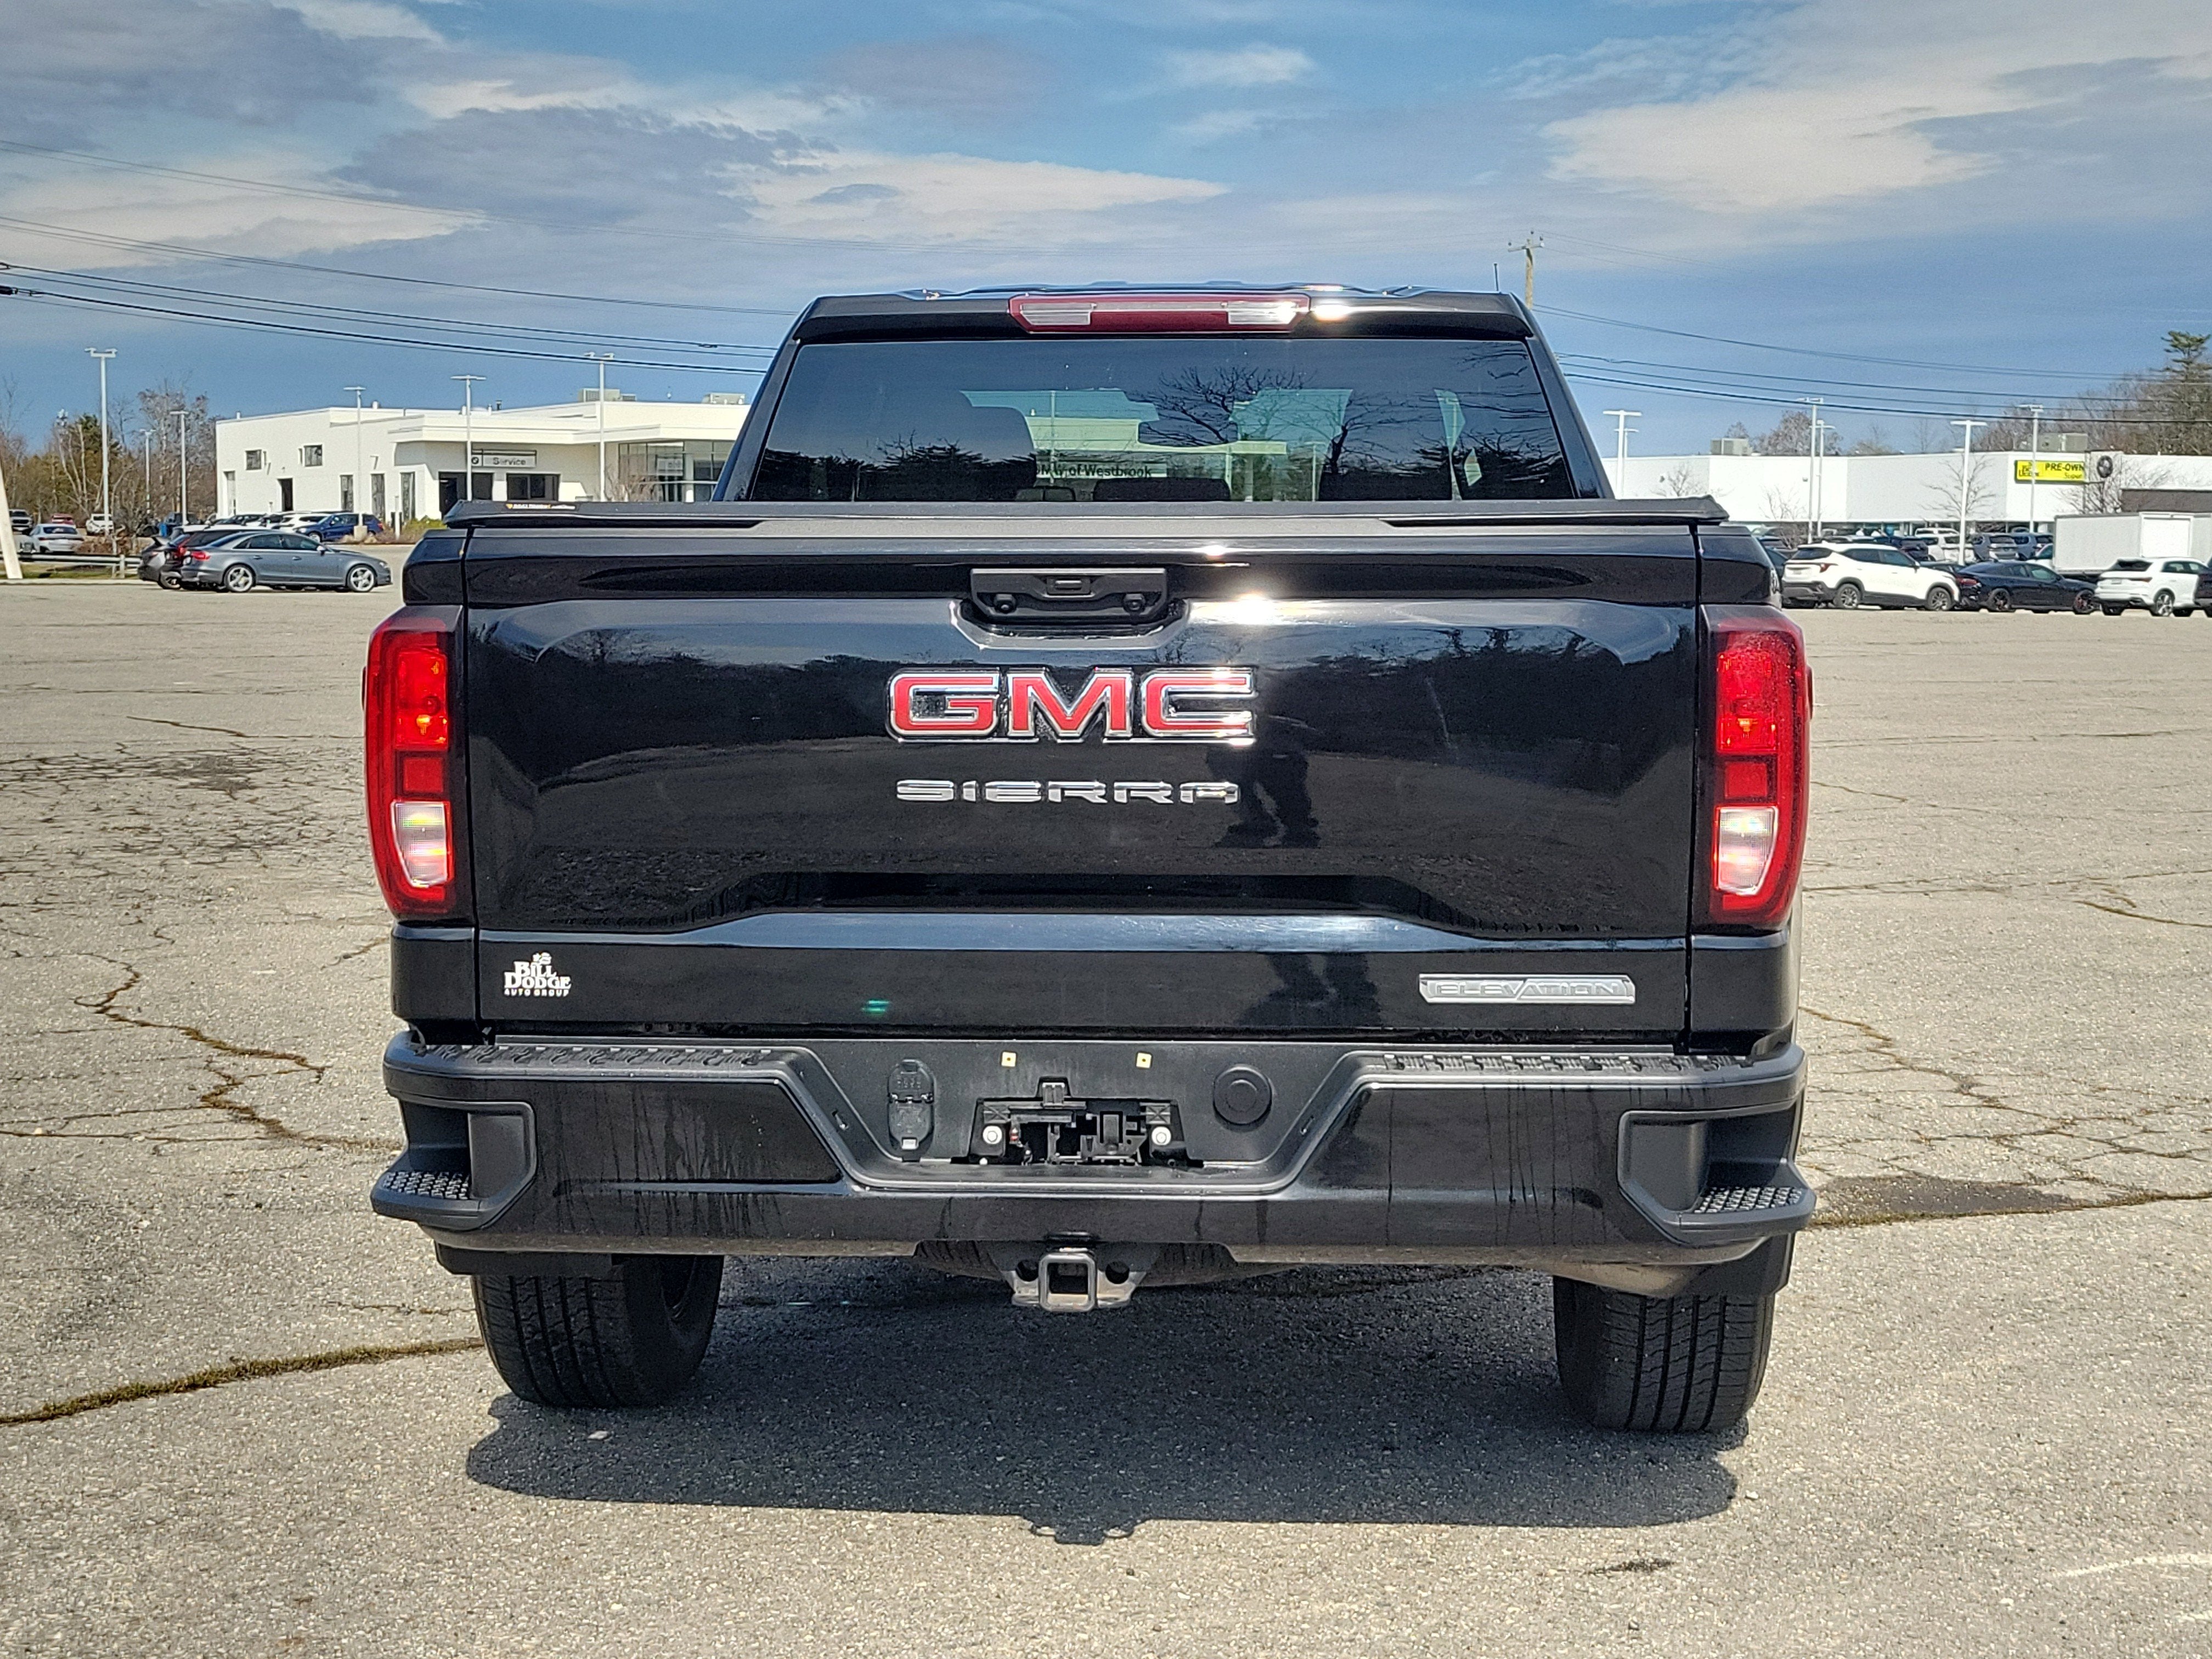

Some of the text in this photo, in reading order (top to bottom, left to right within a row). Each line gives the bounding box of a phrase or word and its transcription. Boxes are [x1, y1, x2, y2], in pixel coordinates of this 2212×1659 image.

[1069, 464, 1082, 476] of
[1084, 464, 1151, 477] Westbrook
[886, 667, 1258, 745] GMC
[896, 780, 1241, 804] SIERRA
[504, 989, 569, 997] AUTO GROUP
[1436, 980, 1619, 996] ELEVATION
